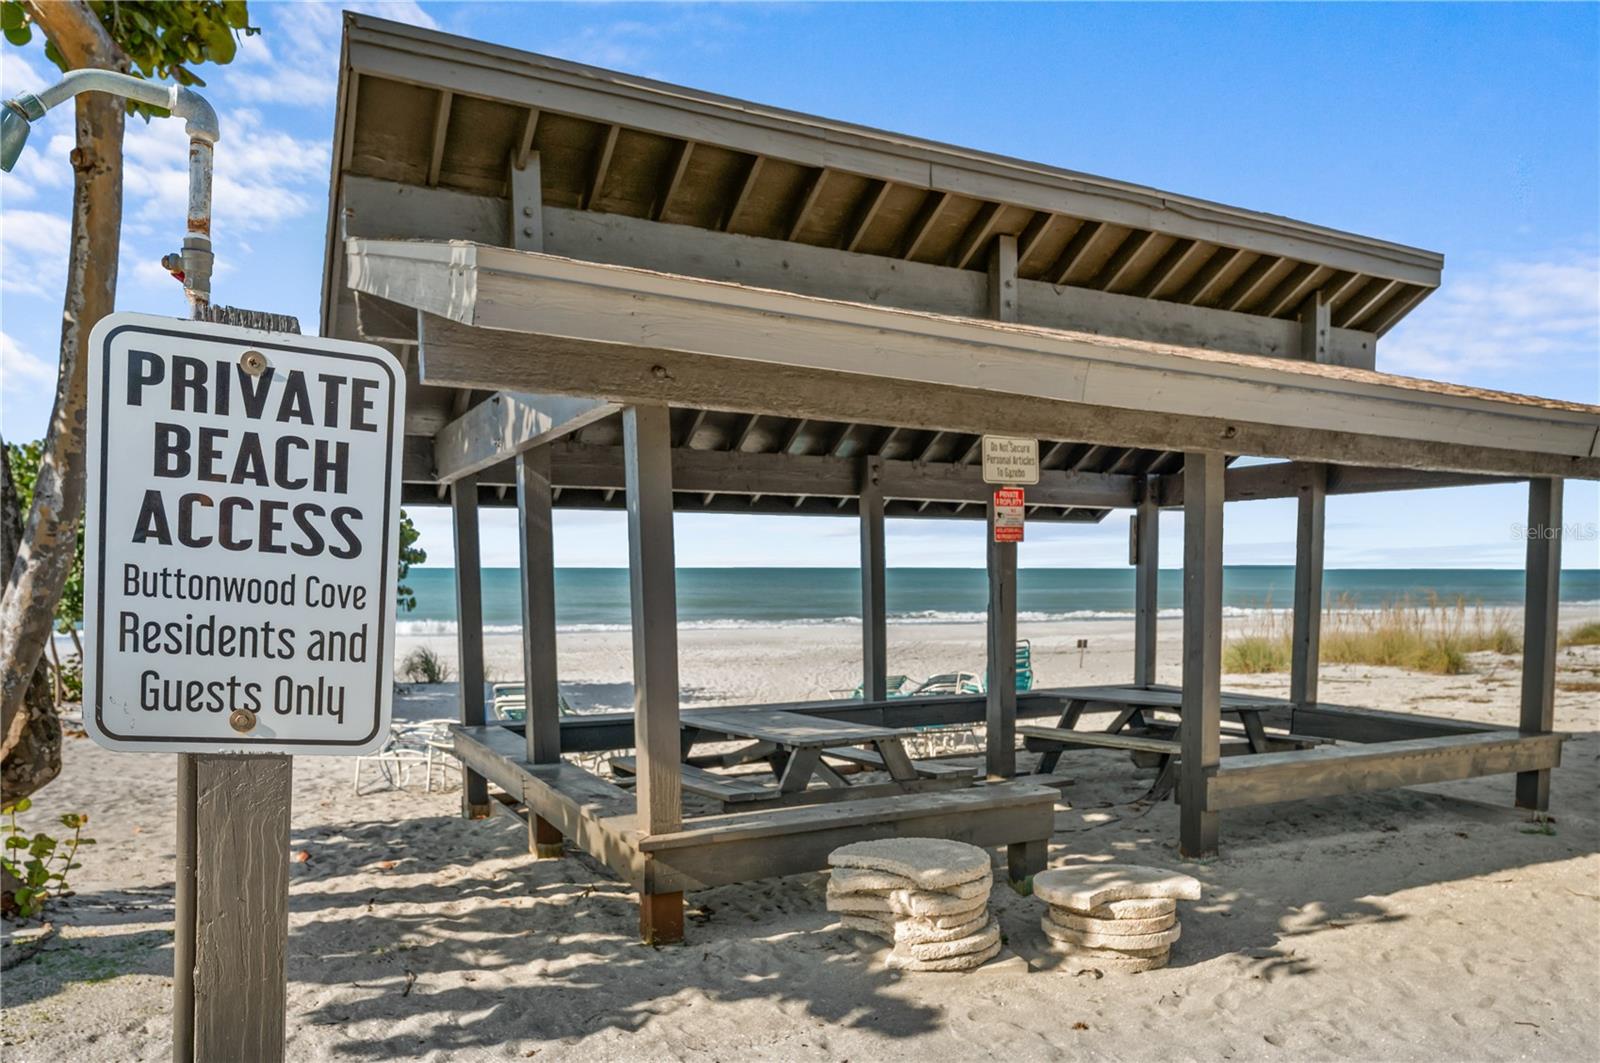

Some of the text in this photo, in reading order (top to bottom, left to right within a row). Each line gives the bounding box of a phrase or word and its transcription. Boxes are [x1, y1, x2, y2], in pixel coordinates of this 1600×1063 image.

[126, 349, 379, 432] PRIVATE
[153, 422, 349, 494] BEACH
[987, 455, 1035, 465] Personal Articles
[991, 442, 1030, 453] Do Not Secure
[997, 468, 1025, 478] To Gazebo
[132, 490, 362, 560] ACCESS
[123, 564, 366, 609] Buttonwood Cove
[119, 612, 367, 663] Residents and
[141, 669, 344, 724] Guests Only
